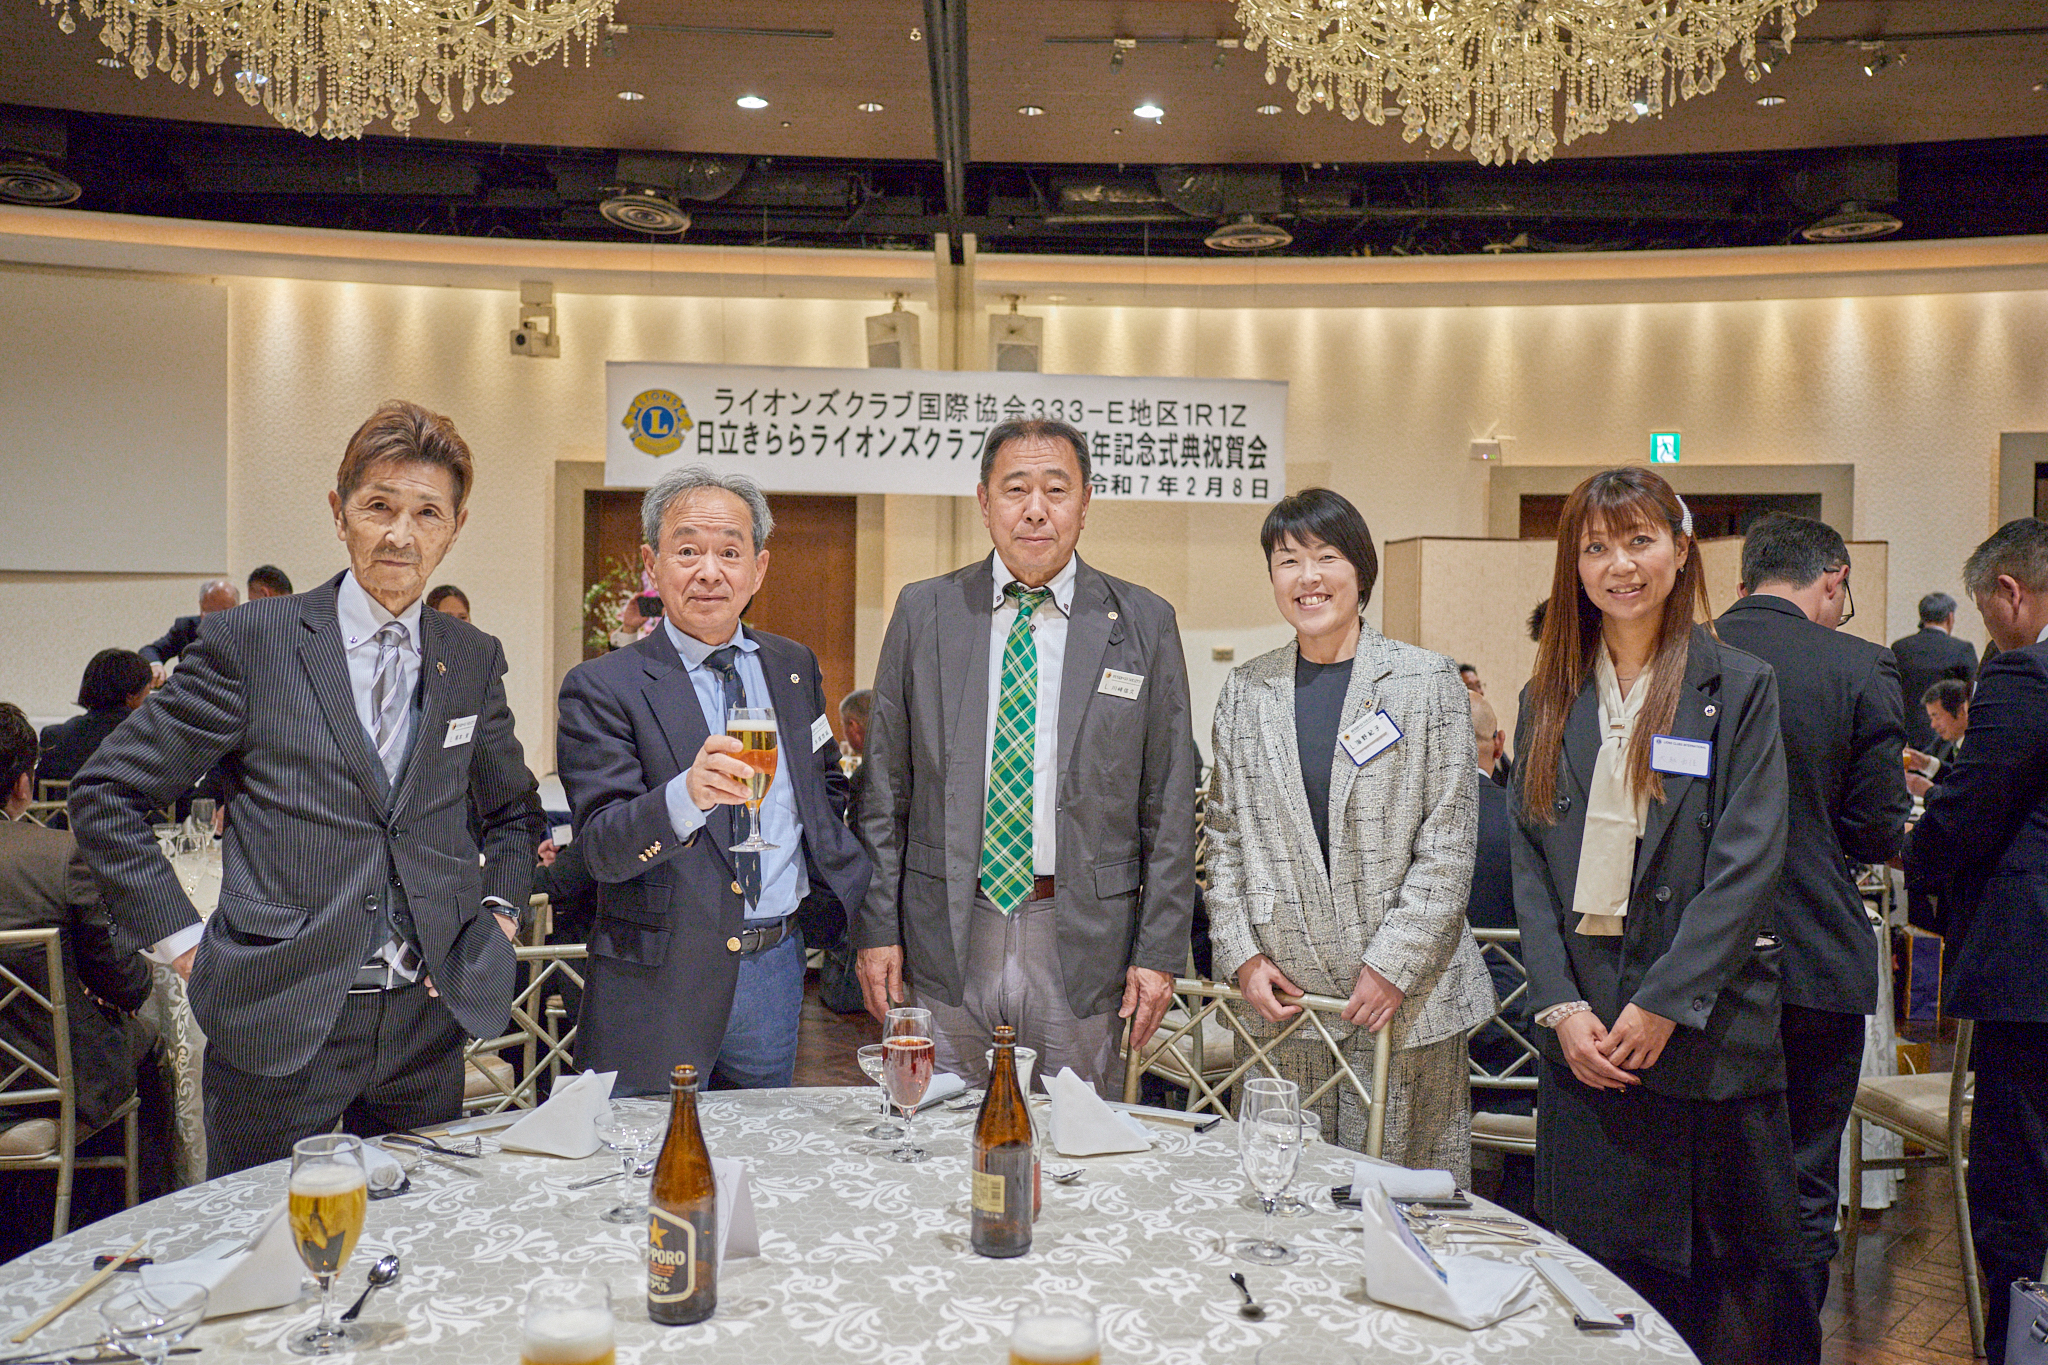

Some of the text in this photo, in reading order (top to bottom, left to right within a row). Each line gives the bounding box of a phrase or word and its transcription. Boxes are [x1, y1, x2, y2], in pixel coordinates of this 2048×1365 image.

[638, 391, 679, 406] LIONS
[648, 409, 669, 435] L
[1083, 430, 1268, 471] 年記念式典祝賀会
